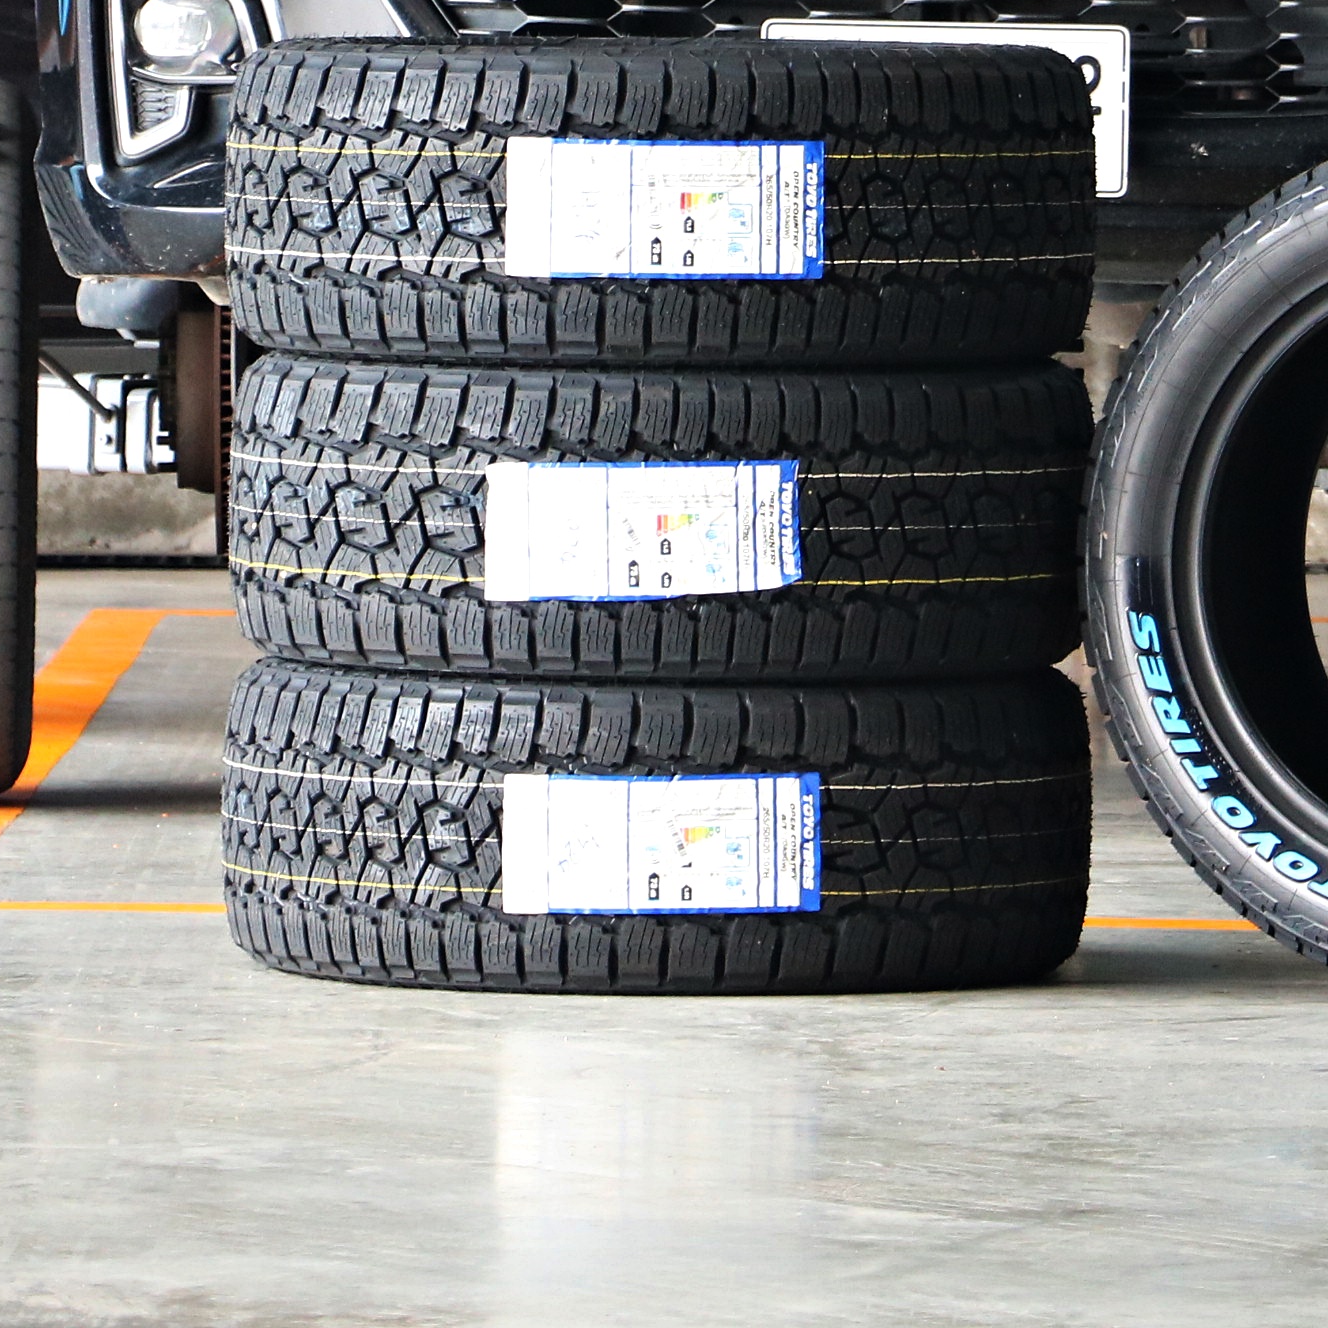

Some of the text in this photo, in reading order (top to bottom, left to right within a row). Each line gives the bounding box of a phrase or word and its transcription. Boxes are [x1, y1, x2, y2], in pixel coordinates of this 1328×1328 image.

[805, 162, 818, 258] TOYO TIRES
[781, 481, 793, 526] TOYO
[1125, 606, 1221, 792] TIRES
[802, 794, 815, 888] TOYO TIRES
